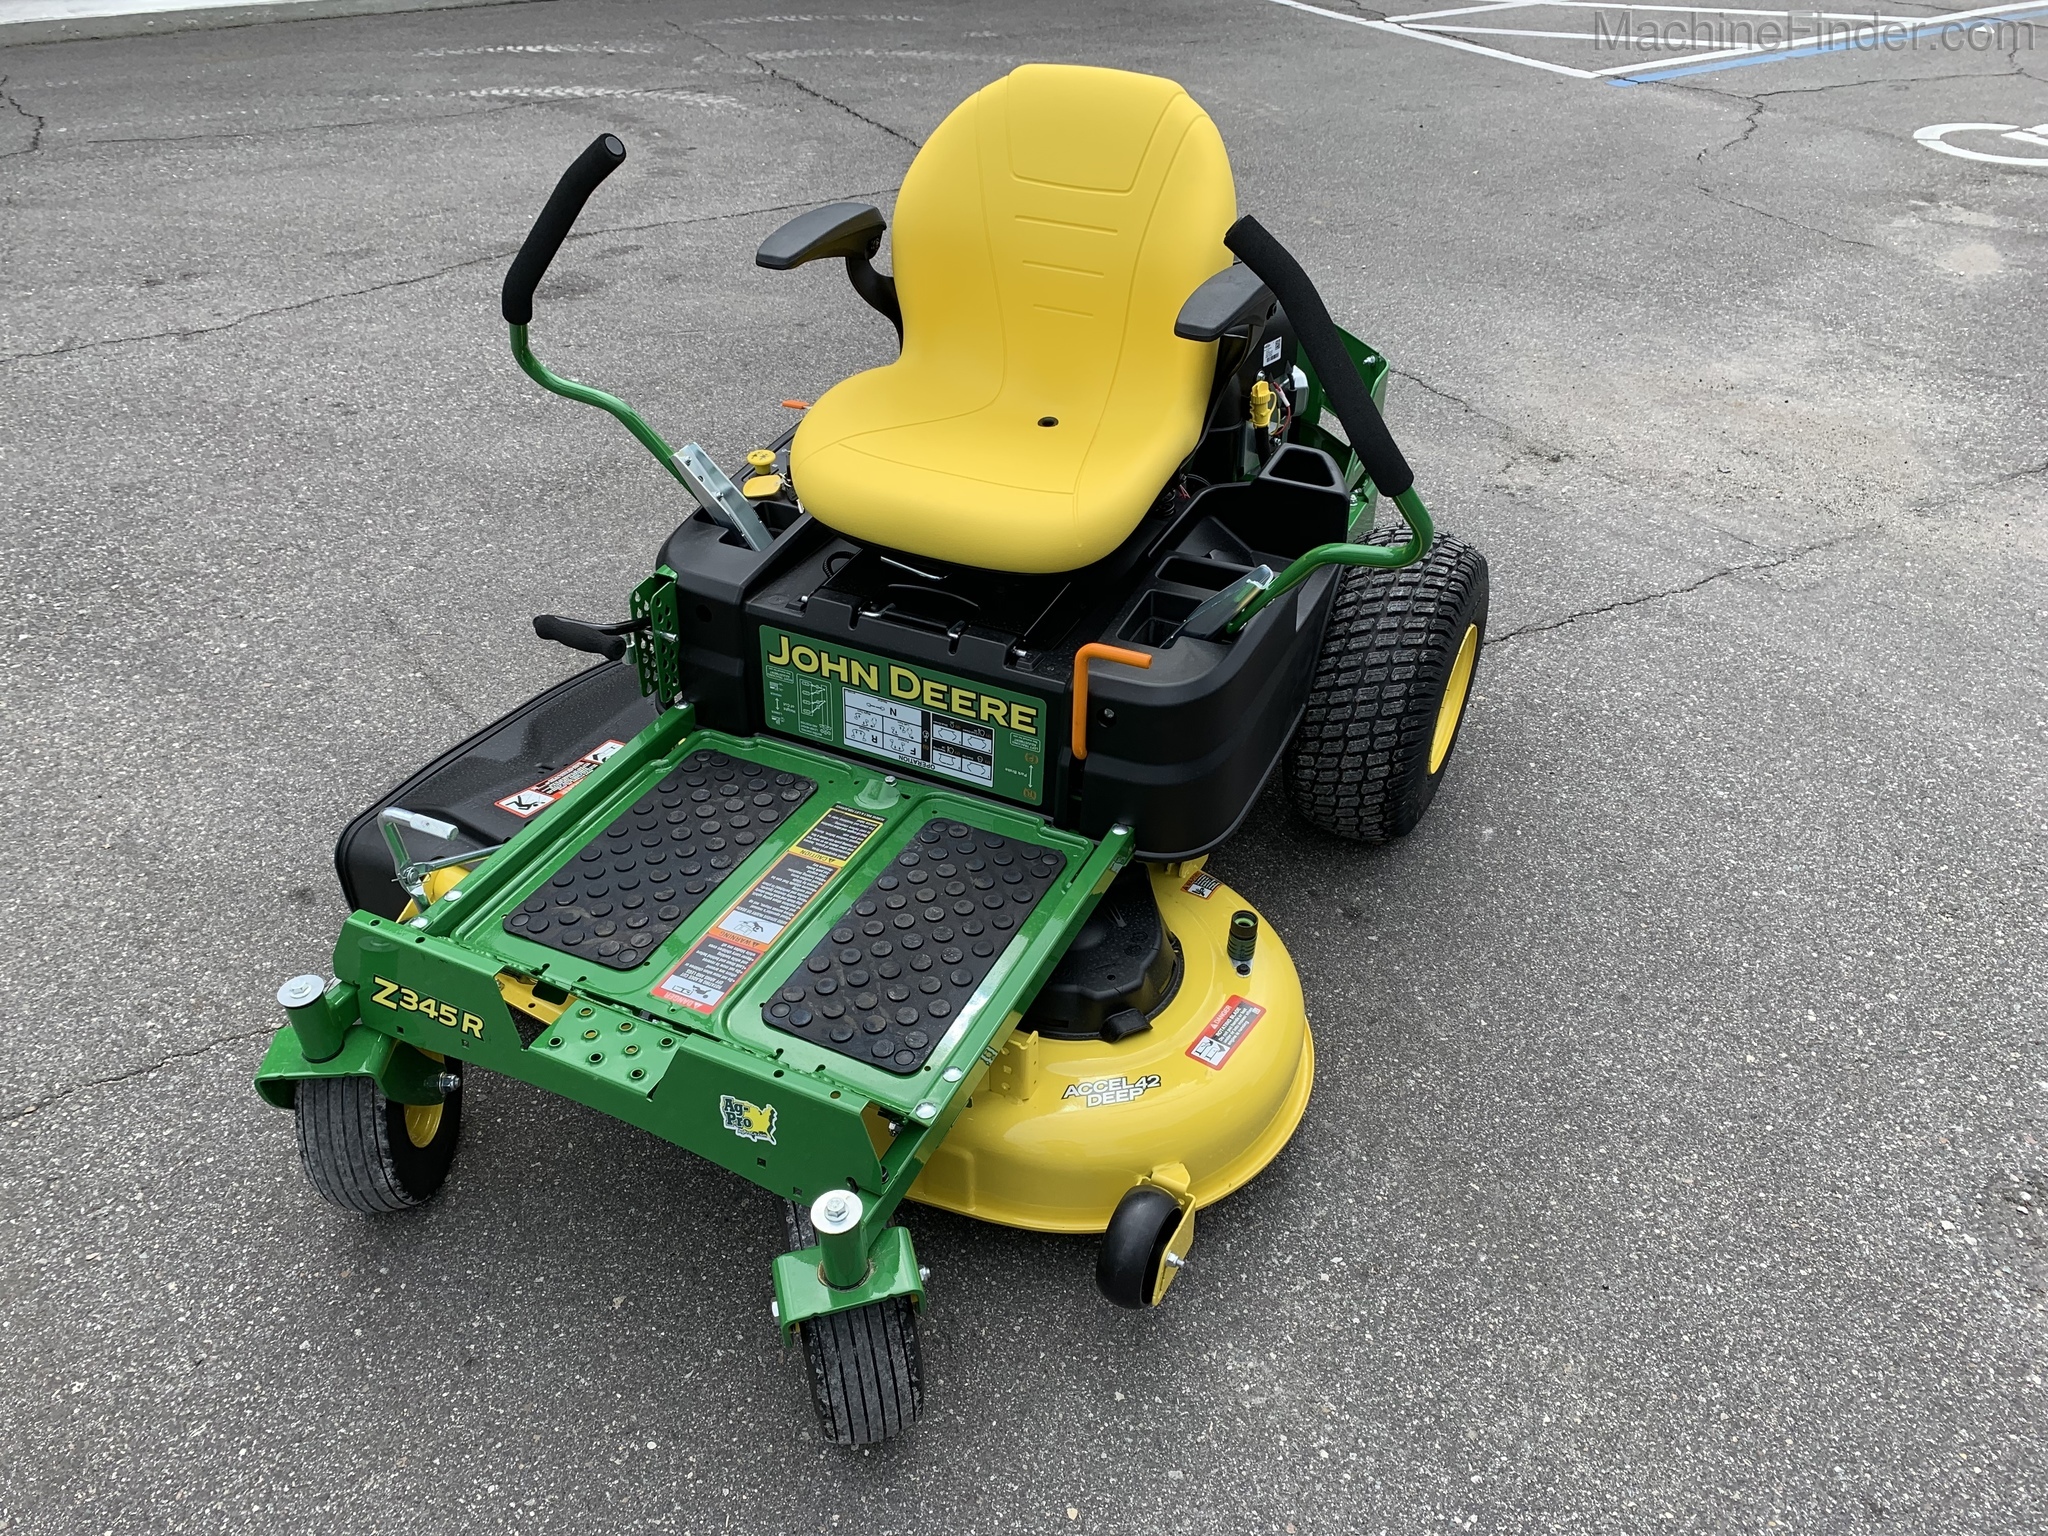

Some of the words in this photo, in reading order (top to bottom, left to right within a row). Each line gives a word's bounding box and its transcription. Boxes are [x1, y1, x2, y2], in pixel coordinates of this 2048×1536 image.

[768, 634, 879, 693] JOHN
[887, 665, 1038, 734] DEERE
[889, 706, 896, 716] N
[871, 734, 877, 743] R
[898, 754, 935, 769] OPERATION
[800, 849, 828, 861] CAUTION
[718, 930, 752, 946] WARNING
[663, 991, 695, 1007] DANGER
[1212, 1004, 1232, 1025] DANGER
[1086, 1087, 1145, 1107] DEEP
[726, 1111, 753, 1128] Pro
